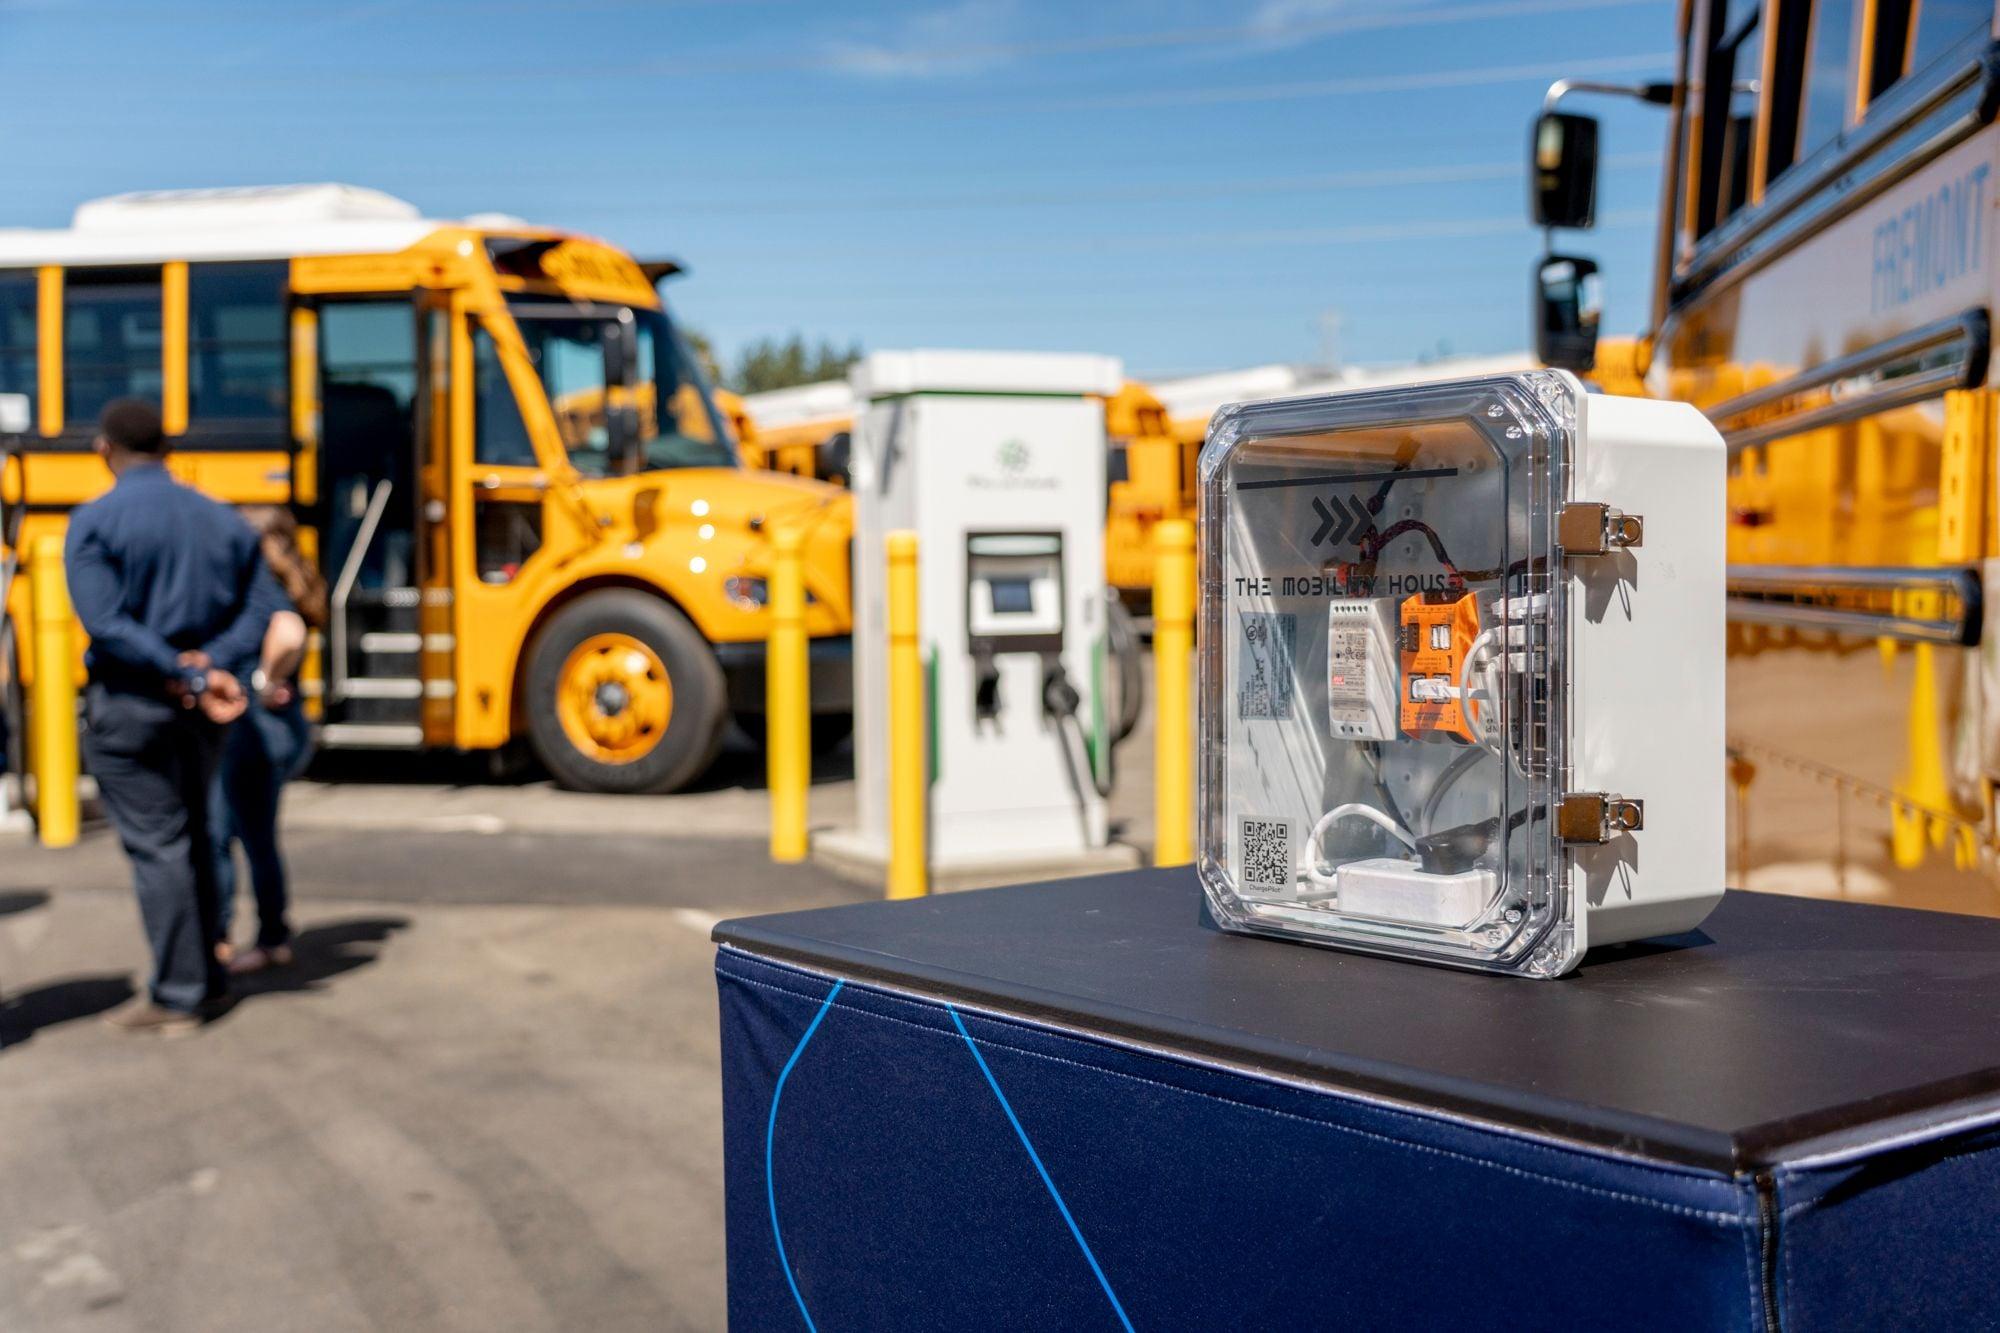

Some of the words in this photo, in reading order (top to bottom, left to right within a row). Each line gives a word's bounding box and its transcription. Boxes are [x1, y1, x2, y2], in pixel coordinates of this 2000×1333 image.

[1872, 164, 1989, 312] FREMONT
[1235, 577, 1272, 597] THE
[1282, 575, 1378, 597] MOBILITY
